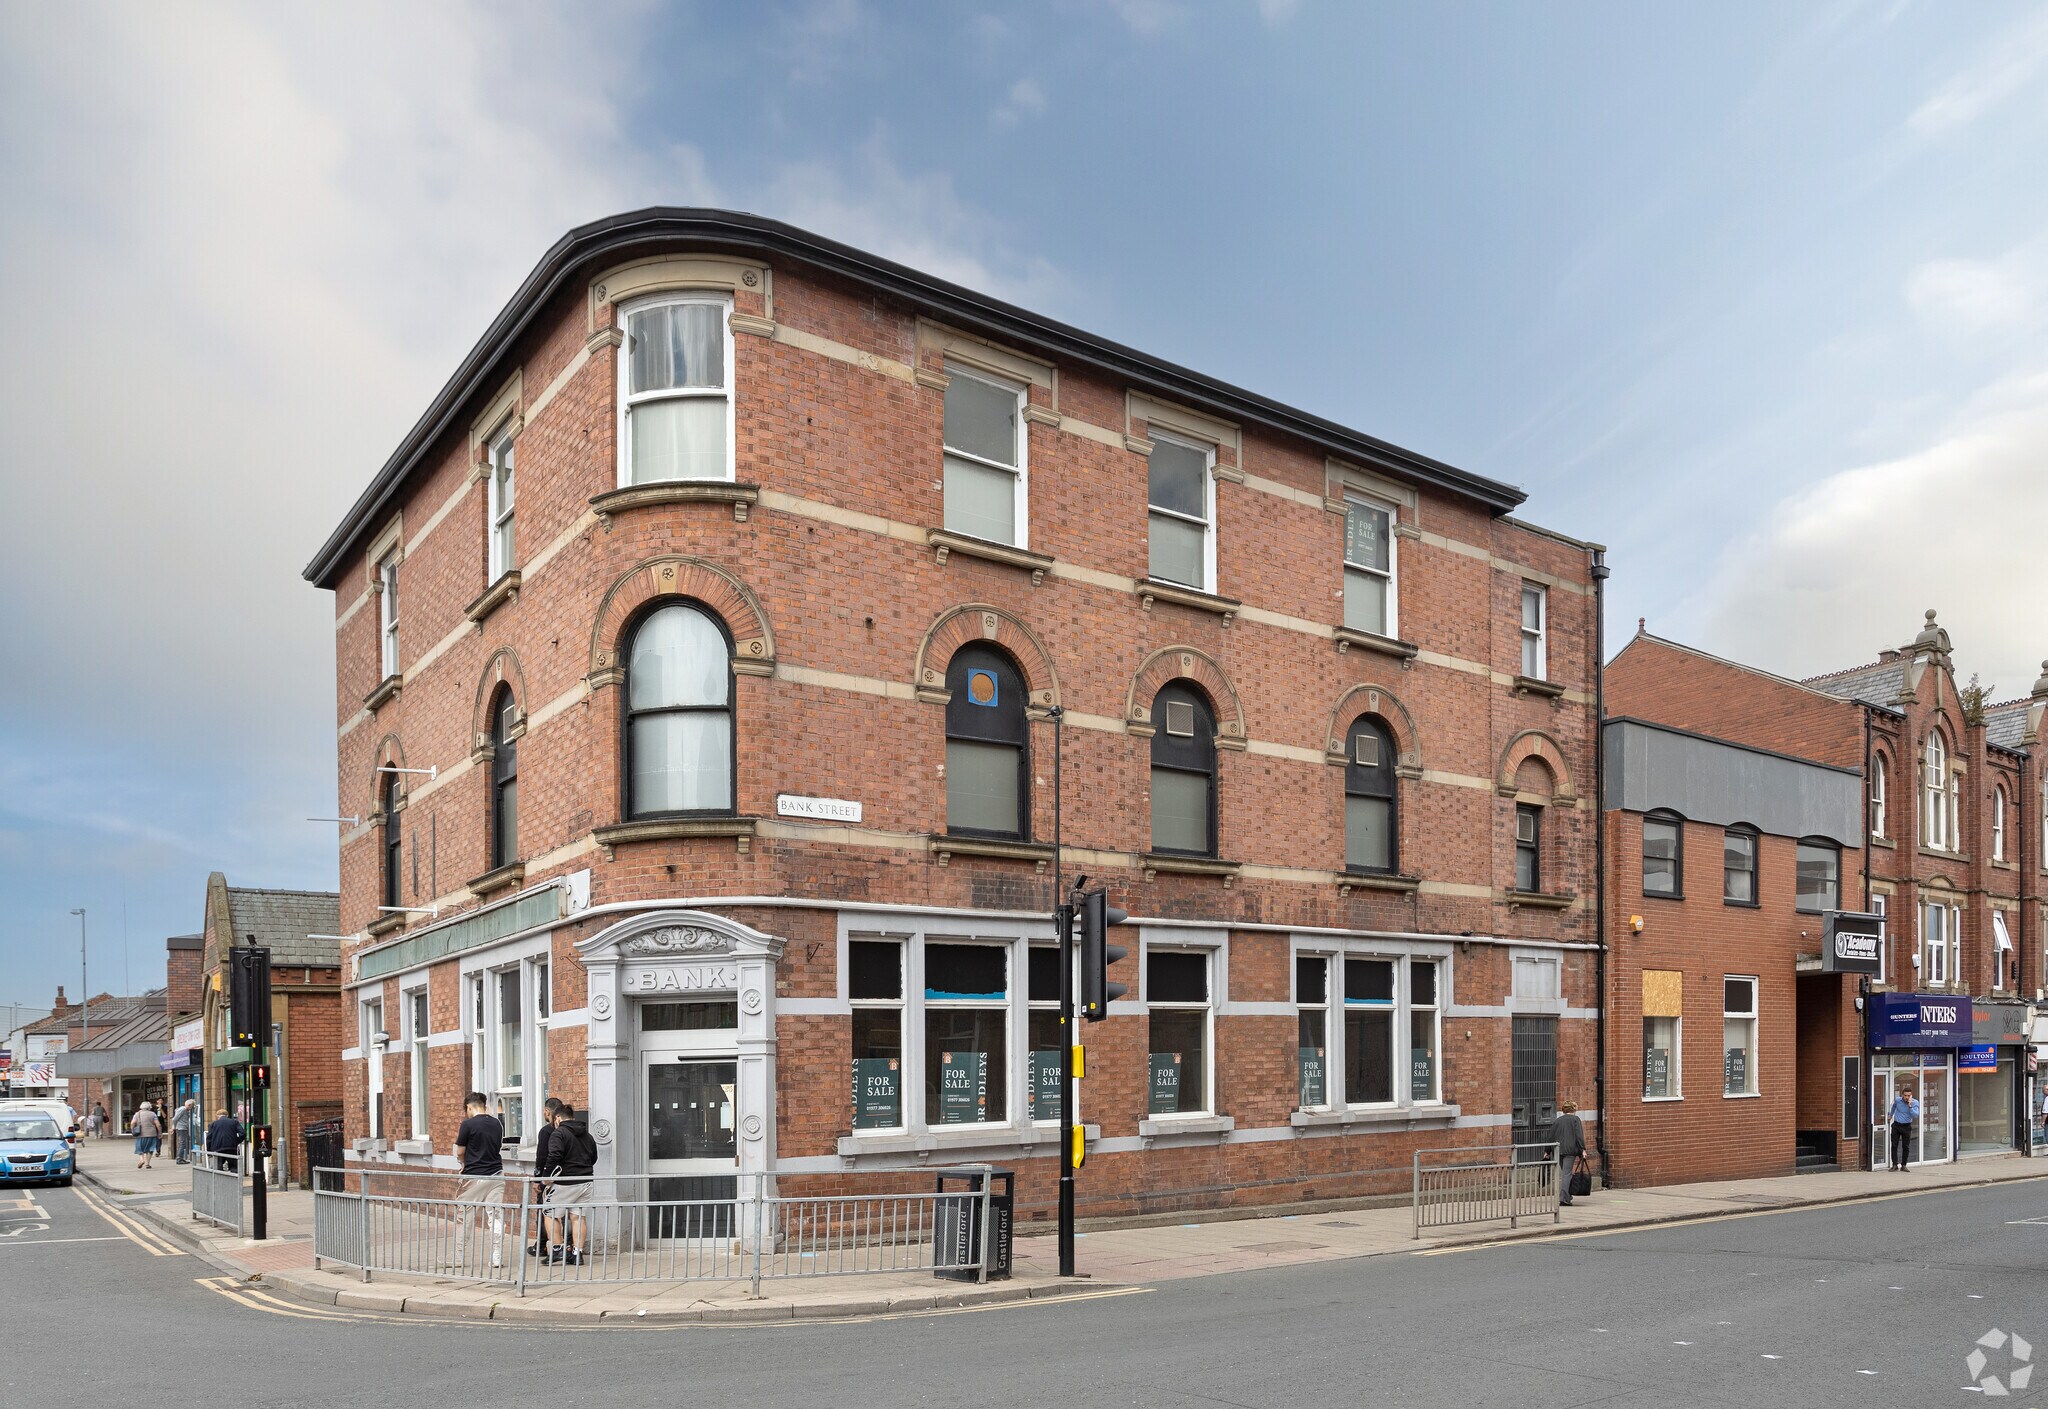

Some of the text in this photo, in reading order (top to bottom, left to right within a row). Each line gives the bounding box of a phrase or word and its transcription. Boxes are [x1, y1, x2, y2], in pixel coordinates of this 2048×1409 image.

[1360, 520, 1372, 531] FOR
[1358, 530, 1376, 540] SALE
[781, 800, 857, 816] BANK STREET
[1848, 936, 1876, 952] Academy
[640, 968, 726, 990] BANK
[946, 1070, 966, 1078] FOR
[1043, 1068, 1061, 1076] FOR
[1158, 1069, 1174, 1077] FOR
[868, 1077, 890, 1086] FOR
[945, 1080, 970, 1088] SALE
[1042, 1077, 1060, 1085] SAL
[1157, 1078, 1178, 1086] SALE
[867, 1087, 894, 1096] SALE
[998, 1210, 1007, 1268] Castleford
